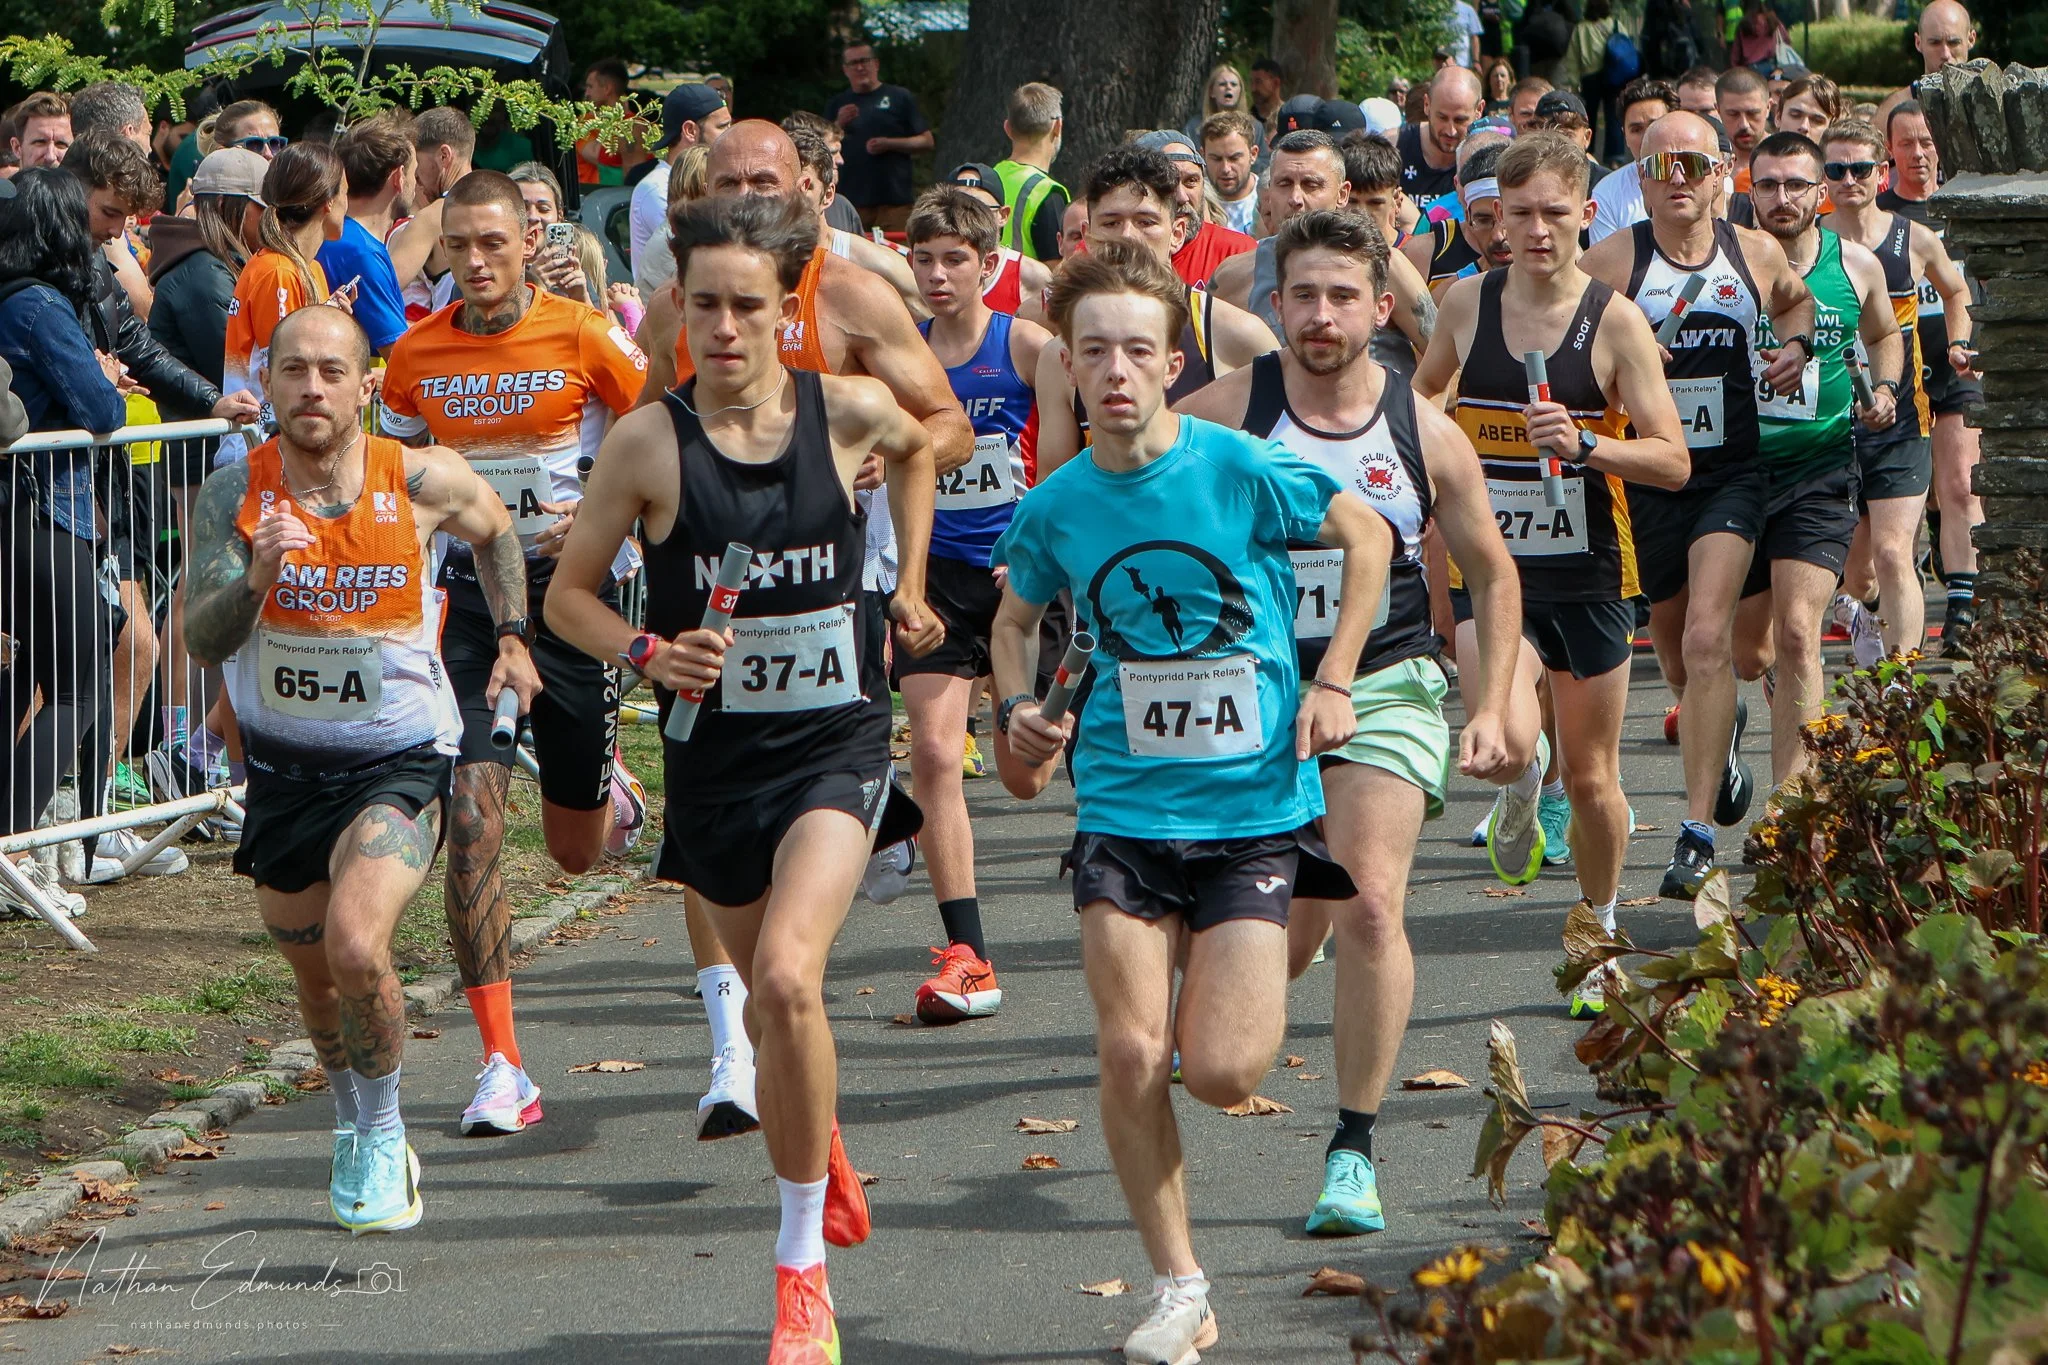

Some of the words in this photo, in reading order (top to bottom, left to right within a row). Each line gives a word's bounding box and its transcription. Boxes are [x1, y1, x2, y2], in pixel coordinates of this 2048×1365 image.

[1574, 317, 1591, 350] soar
[1669, 328, 1736, 348] LWYN
[420, 374, 490, 398] TEAM
[495, 369, 566, 394] REES
[1694, 385, 1716, 393] Relays
[443, 394, 535, 418] GROUP
[966, 398, 1005, 417] IFF
[1478, 424, 1528, 442] ABER
[975, 442, 999, 451] Relays
[495, 468, 512, 476] Park
[513, 466, 541, 475] Relays
[1358, 453, 1399, 471] ISLWYN
[1355, 479, 1386, 501] RUNNING
[1387, 485, 1403, 500] CLUB
[1488, 487, 1528, 497] Pontypridd
[375, 515, 397, 523] GYM
[1495, 509, 1574, 539] 27-A
[277, 563, 327, 587] AM
[334, 565, 408, 588] REES
[275, 587, 378, 613] GROUP
[732, 626, 791, 638] Pontypridd
[794, 623, 816, 635] Park
[818, 615, 846, 631] Relays
[267, 640, 315, 655] Pontypridd
[318, 646, 339, 655] Park
[342, 646, 373, 655] Relays
[741, 647, 845, 692] 37-A
[1129, 672, 1184, 683] Pontypridd
[1187, 672, 1209, 681] Park
[1213, 666, 1246, 678] Relays
[274, 666, 367, 703] 65-A
[1143, 695, 1244, 737] 47-A
[597, 711, 616, 800] TEAM
[864, 779, 881, 810] adidas
